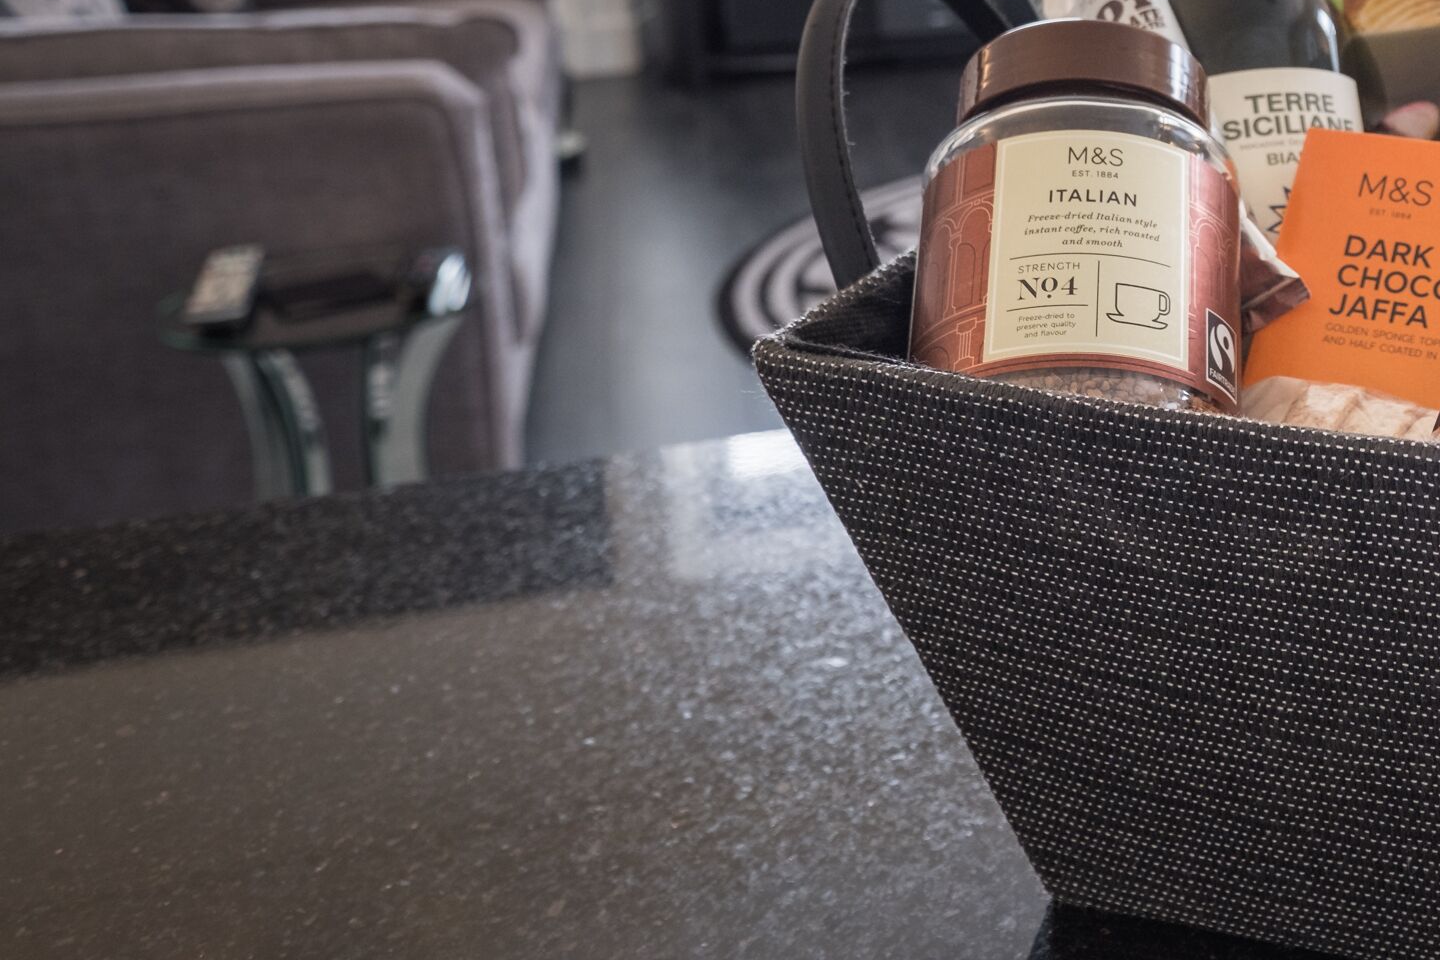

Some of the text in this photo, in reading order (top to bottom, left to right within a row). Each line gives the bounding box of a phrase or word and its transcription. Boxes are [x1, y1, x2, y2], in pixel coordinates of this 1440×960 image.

[1244, 92, 1336, 114] TERRE
[1223, 115, 1354, 140] SICILIANE
[1068, 147, 1123, 166] M&S
[1267, 152, 1301, 166] BIA
[1097, 171, 1118, 179] 1884
[1049, 189, 1137, 207] ITALIAN
[1358, 173, 1434, 206] M&S
[1028, 213, 1158, 228] Freeze-dried Italian style
[1024, 224, 1160, 241] instant coffee, rich roasted
[1086, 239, 1123, 247] smooth
[1344, 234, 1434, 269] DARK
[1018, 262, 1080, 274] STRENGTH
[1018, 313, 1064, 322] Freeze-dried
[1328, 293, 1428, 328] JAFFA
[1016, 321, 1076, 331] preserve quality
[1325, 323, 1368, 336] GOLDEN
[1373, 329, 1415, 344] SPONGE
[1323, 335, 1345, 346] AND
[1349, 339, 1376, 350] HALF
[1379, 343, 1422, 358] COATED
[1426, 351, 1437, 360] IN
